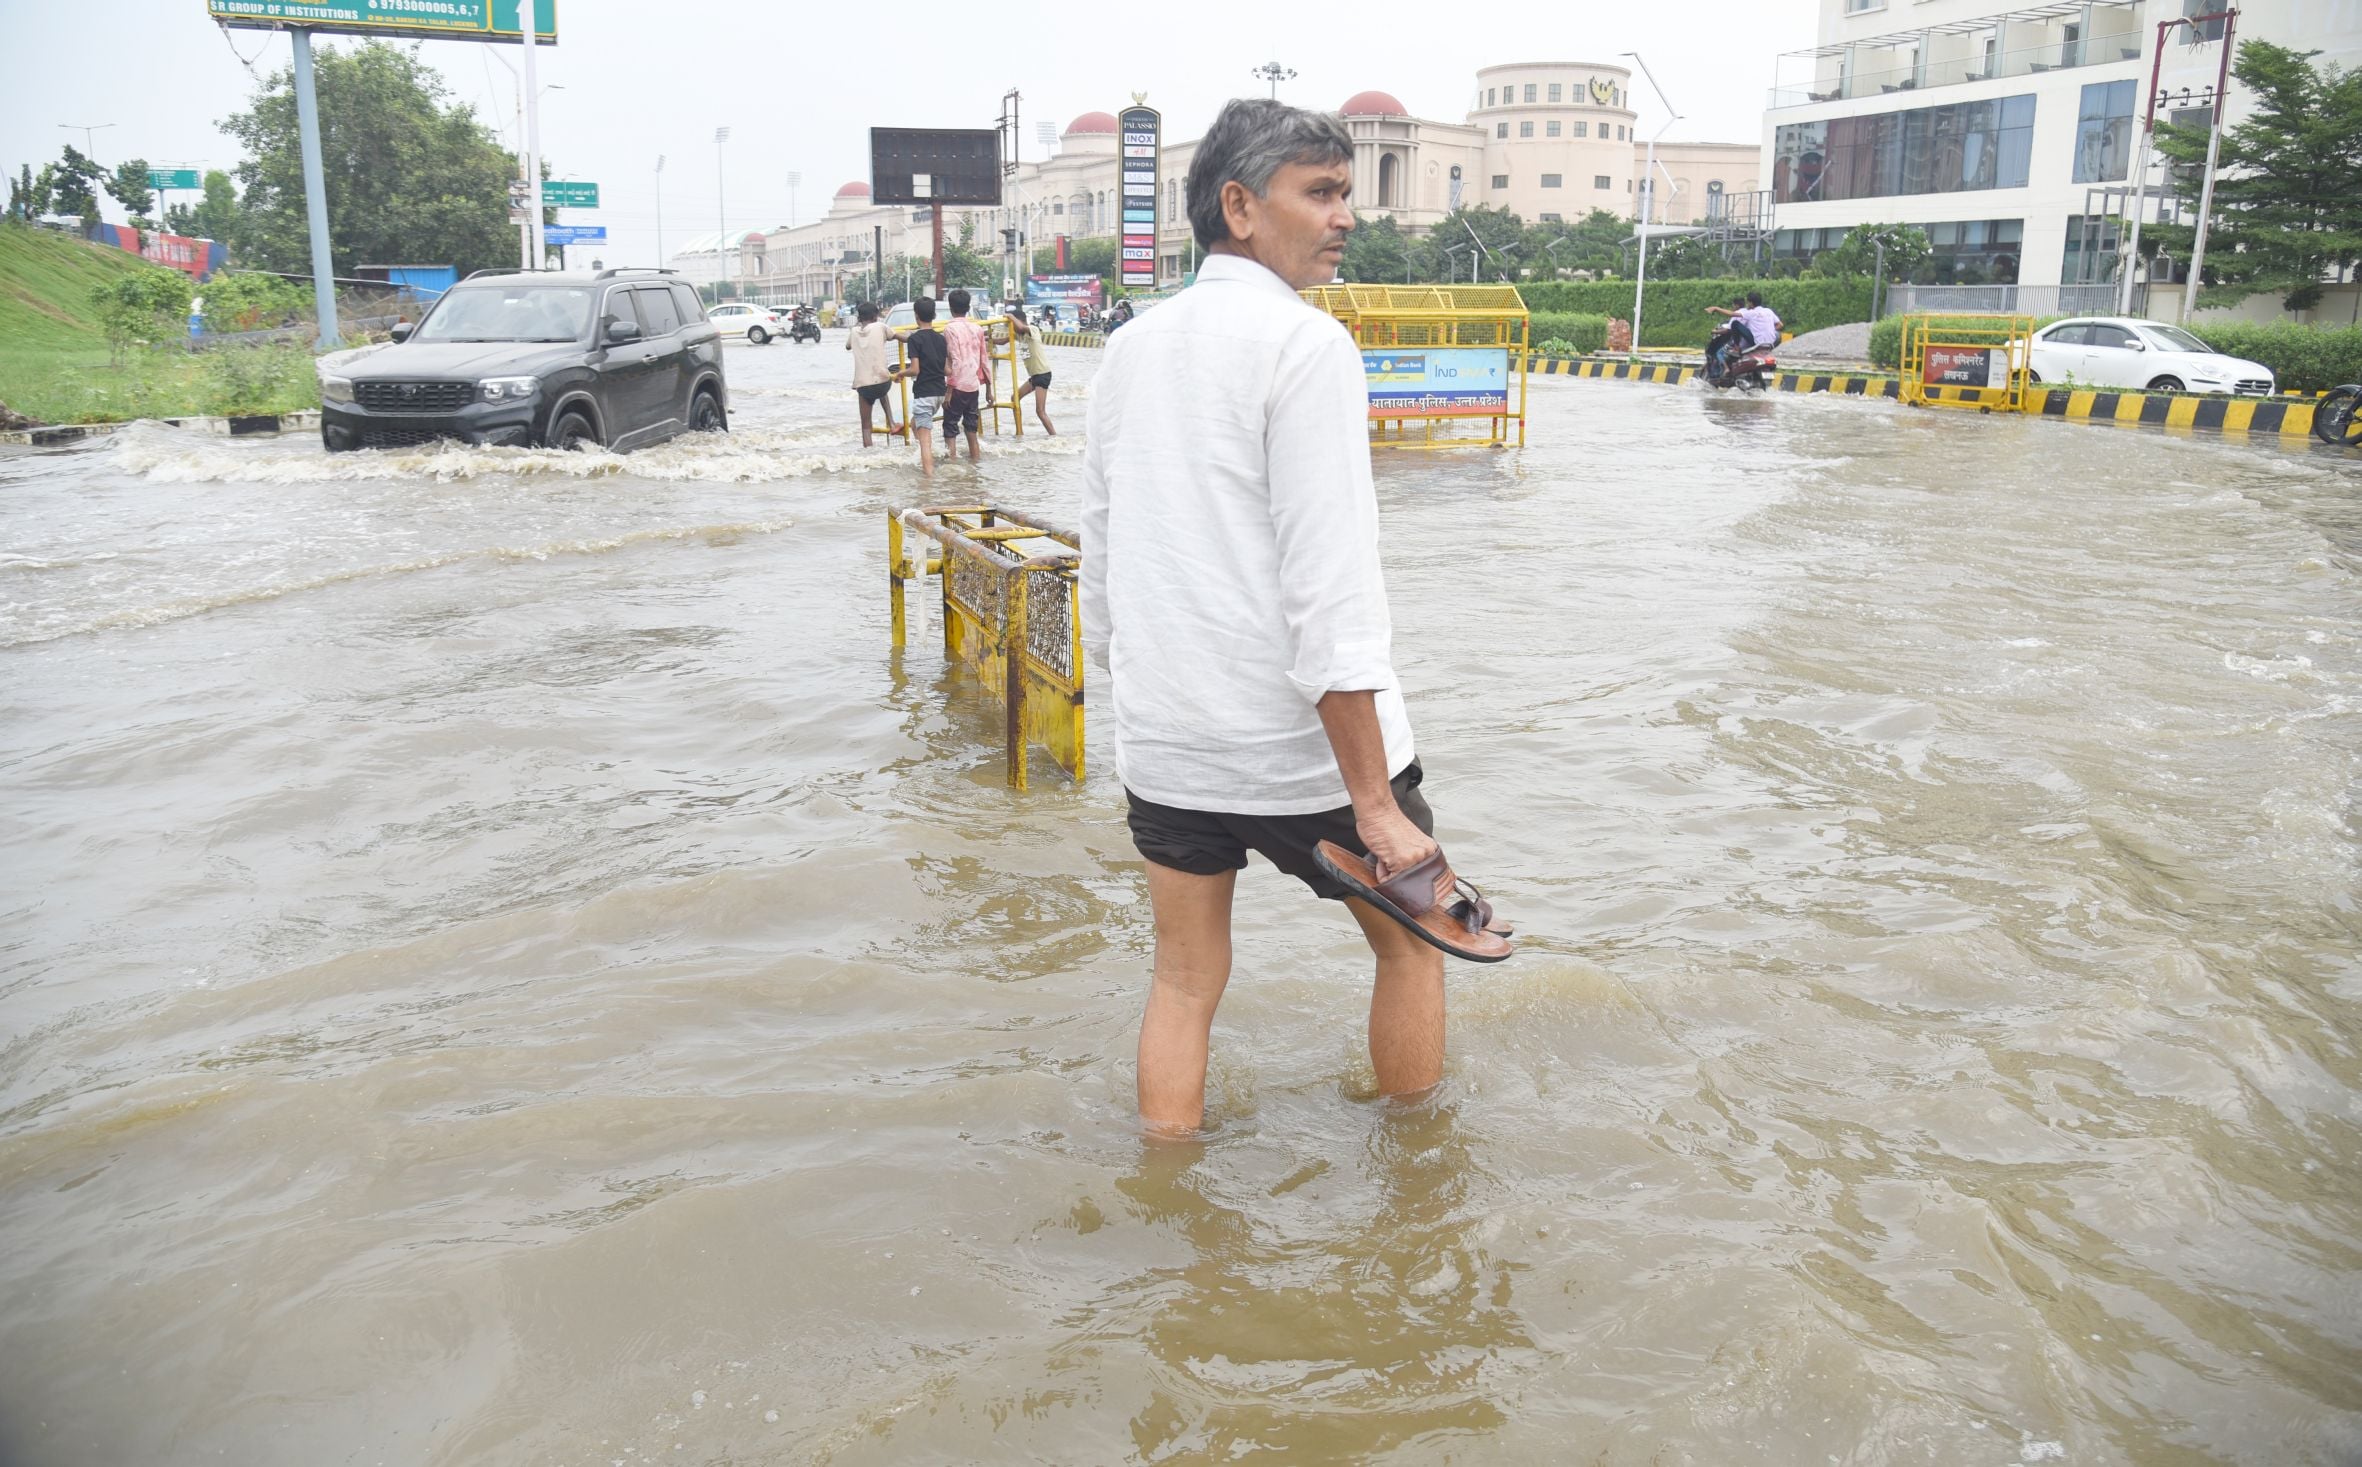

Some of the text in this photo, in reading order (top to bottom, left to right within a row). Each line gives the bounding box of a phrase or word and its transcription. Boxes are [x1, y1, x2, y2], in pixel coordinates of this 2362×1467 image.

[229, 2, 264, 14] GROUP
[267, 5, 281, 15] OF
[285, 5, 359, 20] INSTITUTIONS
[380, 0, 480, 16] 9793000005,6,7
[1126, 134, 1153, 144] INOX
[1125, 249, 1151, 258] max
[1931, 351, 1950, 367] पुलिस
[1943, 369, 1969, 381] लखनऊ
[1372, 398, 1416, 409] यातायात
[1478, 393, 1503, 408] प्रदेश
